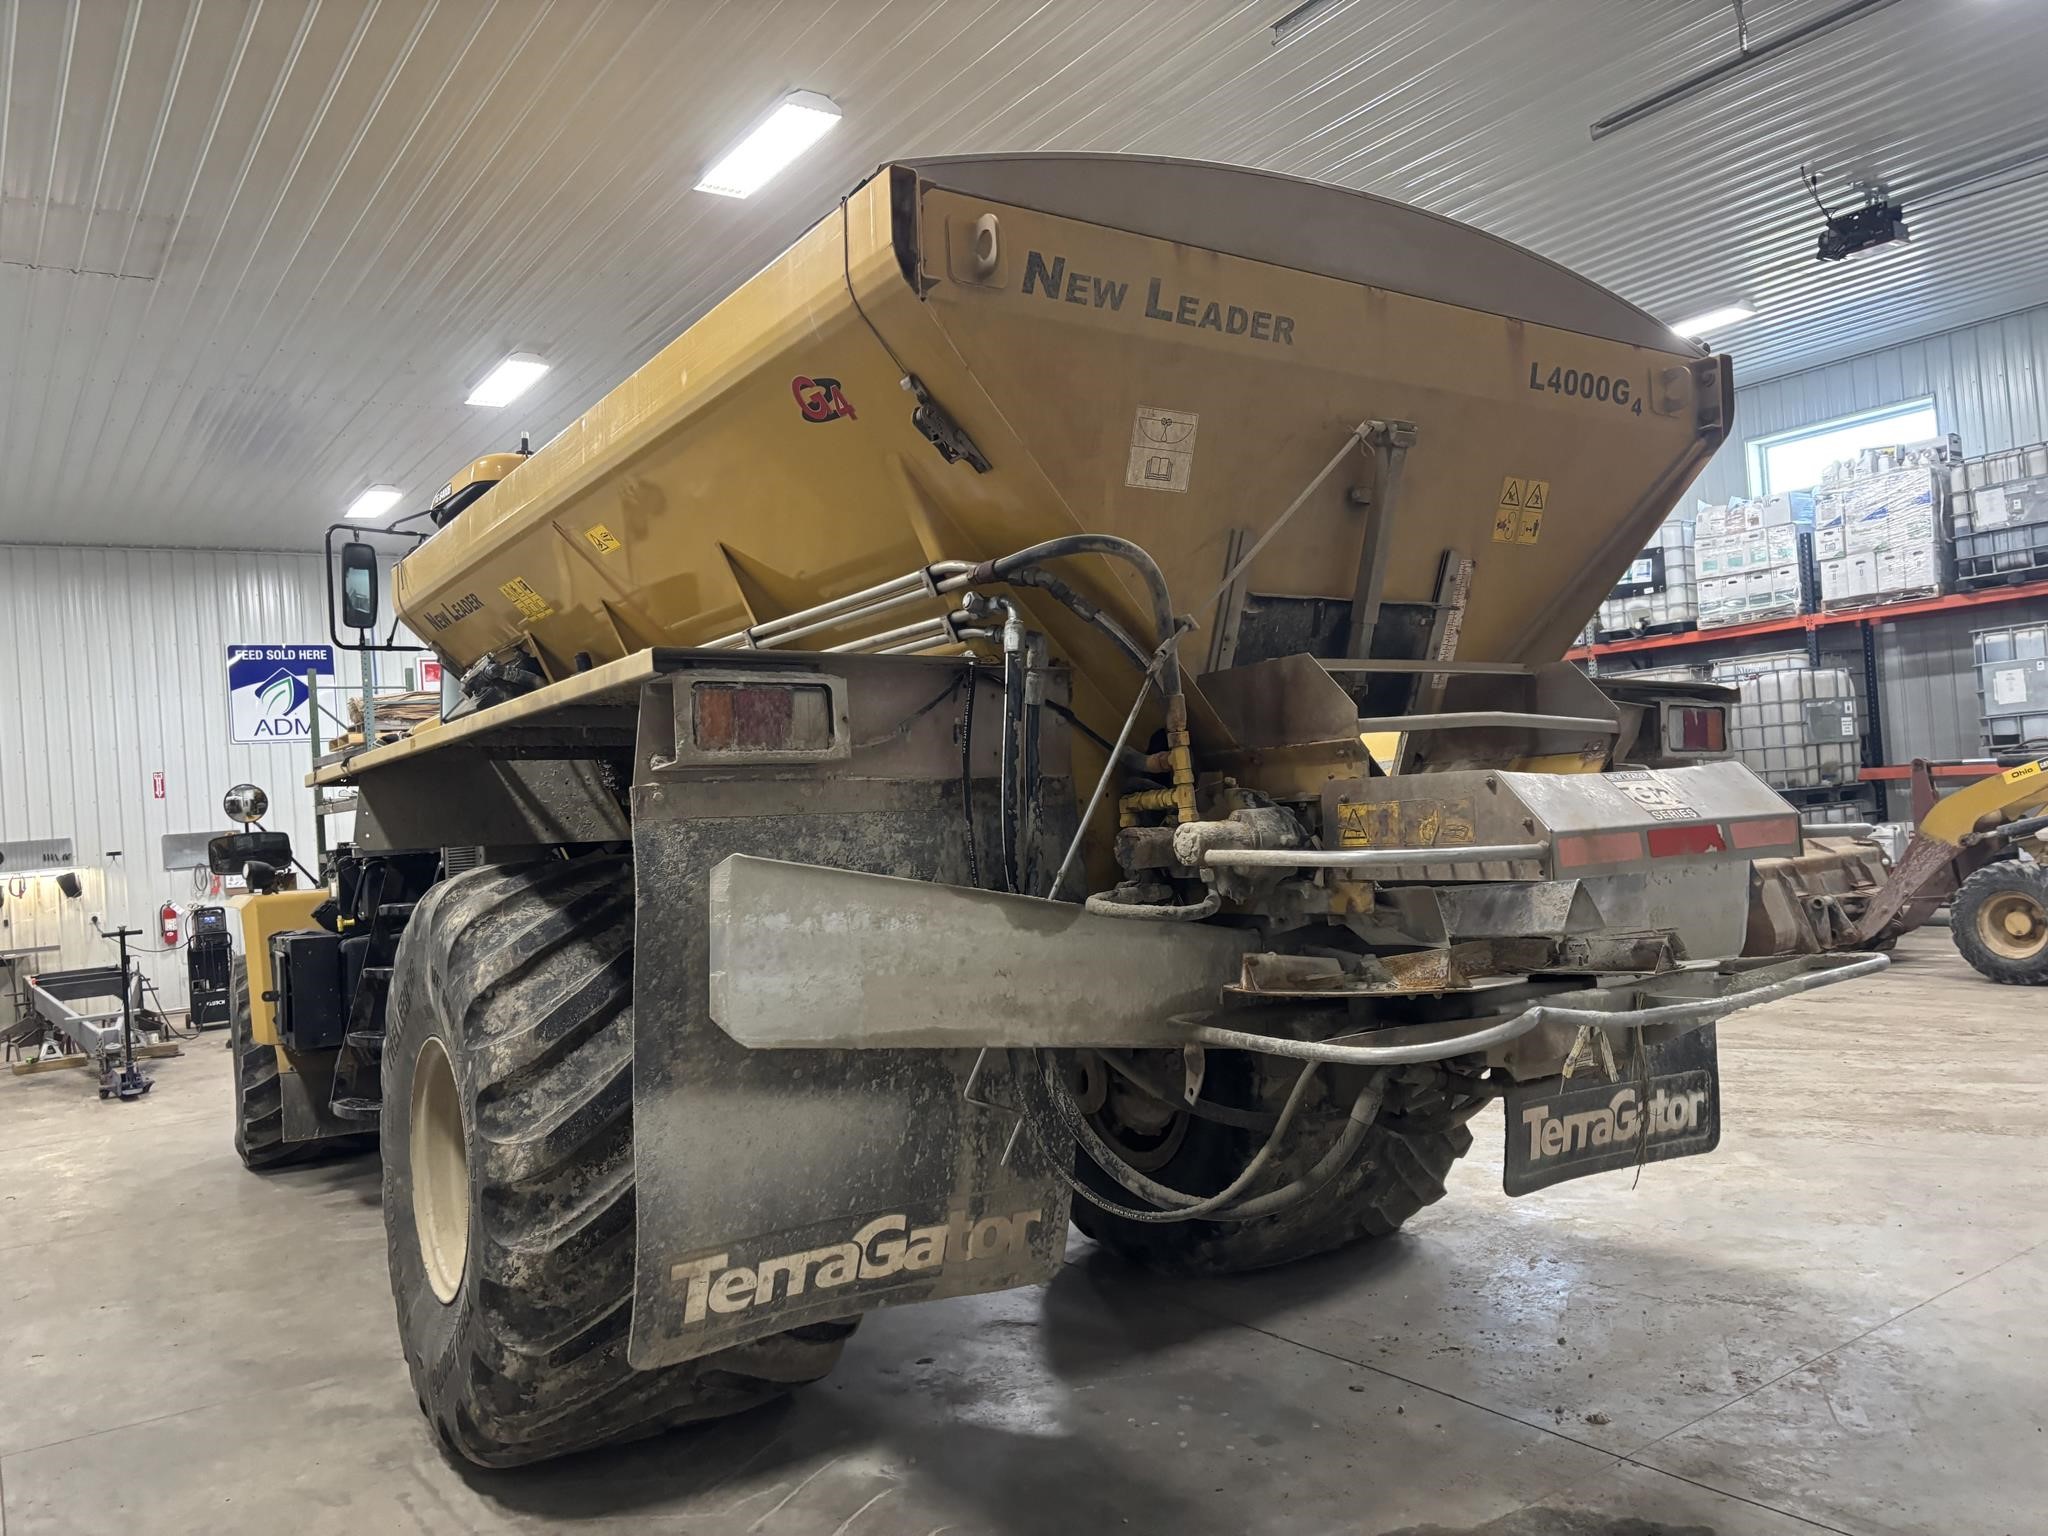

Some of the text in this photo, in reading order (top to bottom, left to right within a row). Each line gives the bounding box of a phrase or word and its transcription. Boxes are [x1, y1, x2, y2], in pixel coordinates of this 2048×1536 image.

[266, 650, 295, 660] SOLD
[299, 650, 327, 660] HERE
[254, 718, 311, 736] ADM
[2011, 767, 2034, 779] Ohio
[1651, 808, 1697, 820] SERIES
[670, 1209, 1042, 1325] TerraGator
